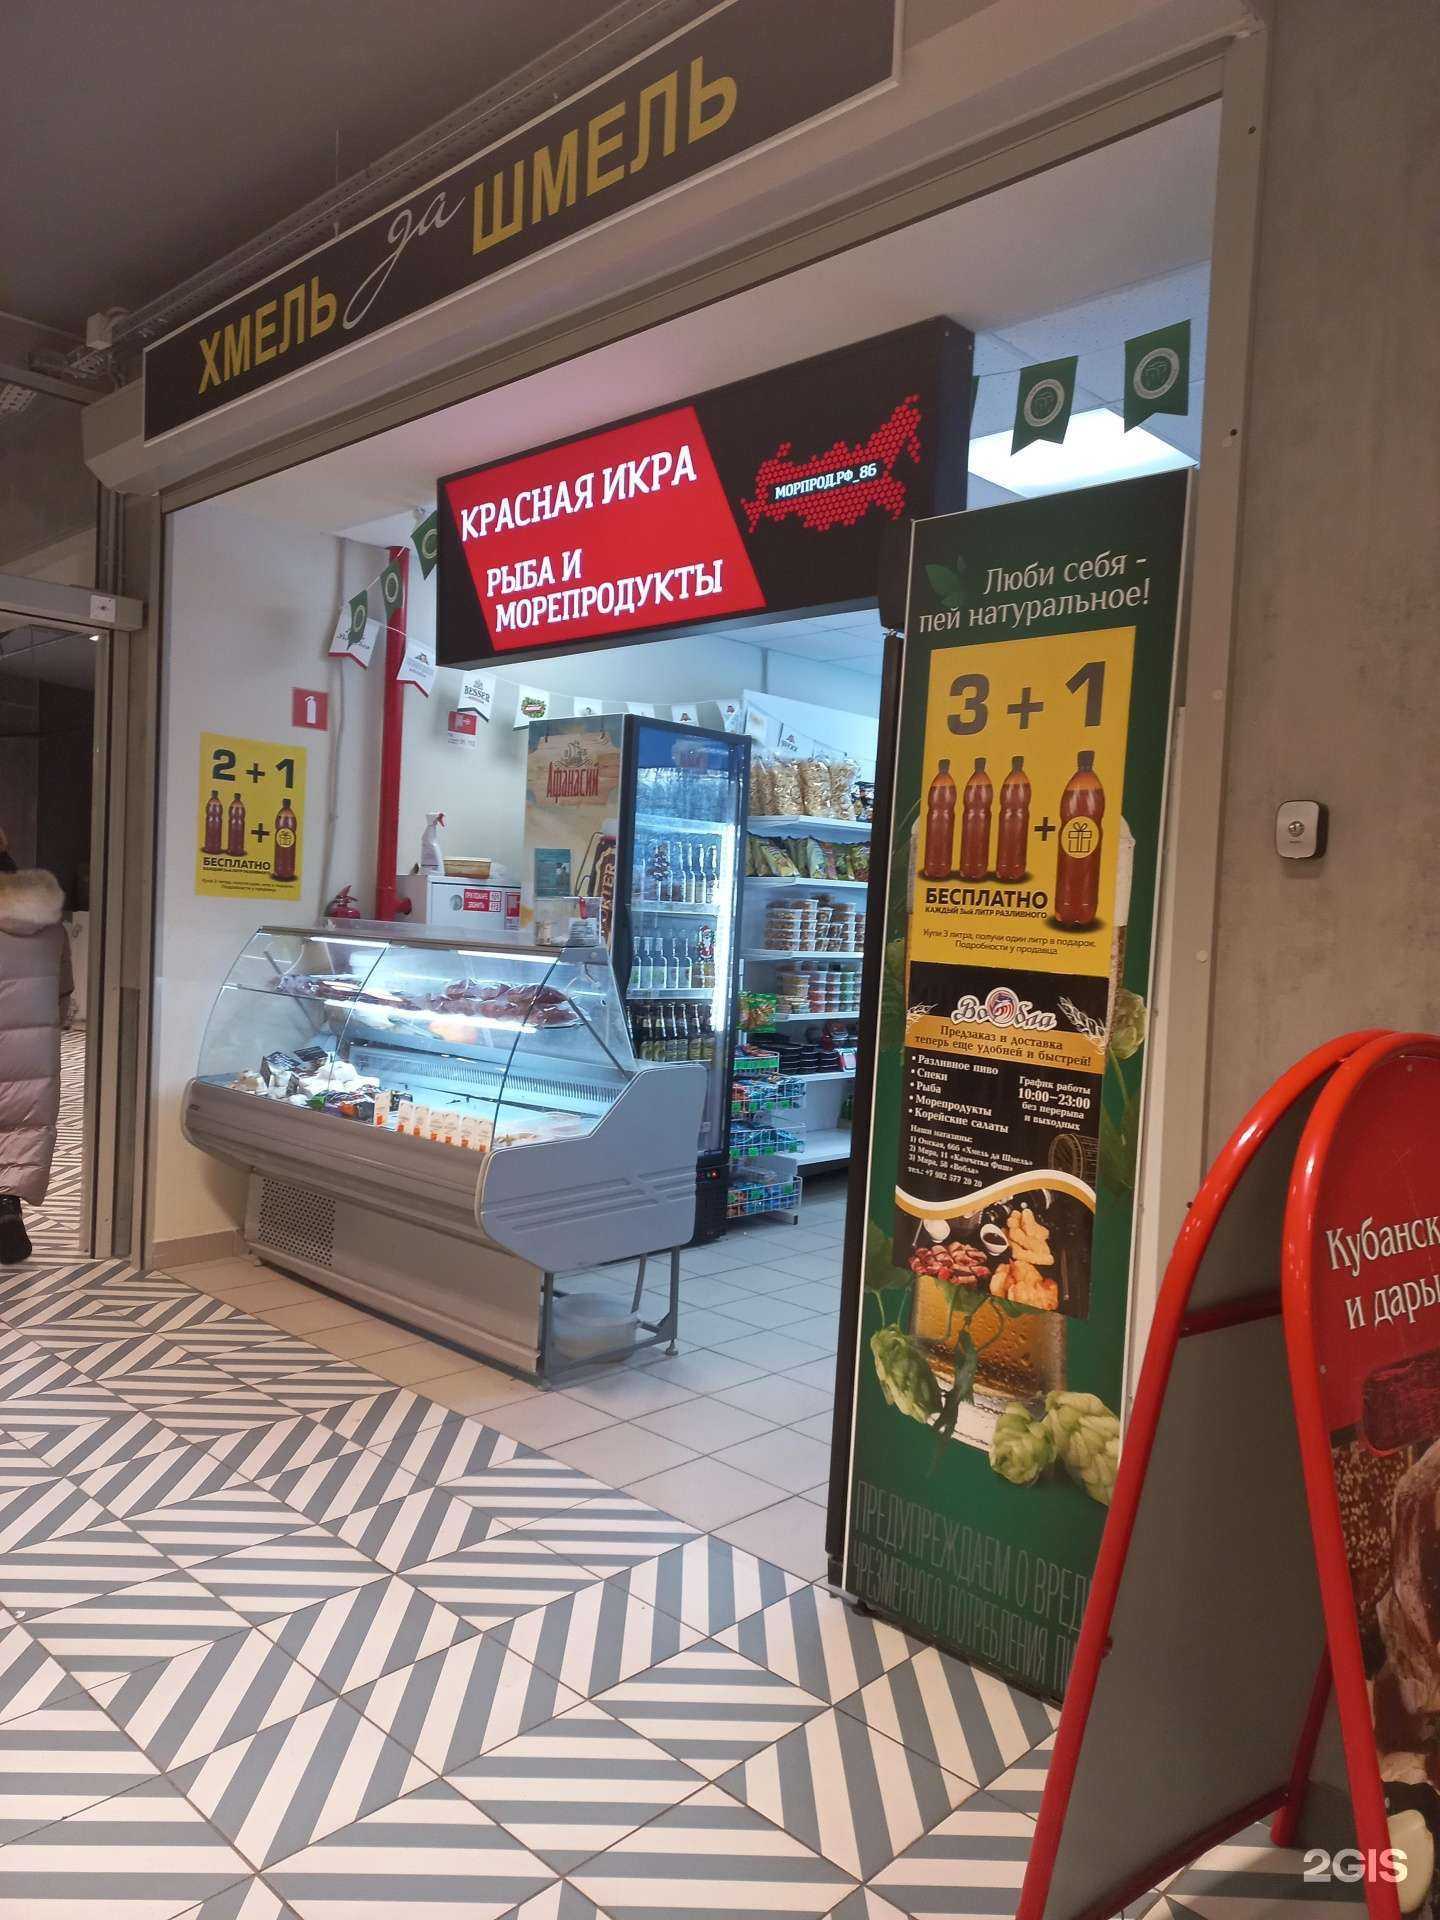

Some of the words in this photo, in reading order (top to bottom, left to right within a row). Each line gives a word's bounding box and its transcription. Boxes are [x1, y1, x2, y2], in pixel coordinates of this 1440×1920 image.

[198, 275, 338, 394] ХМЕЛЬ
[472, 55, 738, 255] ШМЕЛЬ
[461, 474, 594, 542] КРАСНАЯ
[601, 445, 697, 506] ИКРА
[775, 463, 877, 499] МОРПРОД.РФ_86
[486, 555, 555, 597] РЫБА
[562, 548, 582, 581] И
[984, 561, 1054, 595] Люби
[1063, 550, 1128, 580] себя
[495, 560, 723, 633] МОРЕПРОДУКТЫ
[919, 607, 960, 633] пей
[969, 578, 1150, 627] натуральное!
[947, 674, 990, 735] 3
[1007, 687, 1044, 729] +
[1065, 661, 1106, 727] 1
[212, 749, 236, 781] 2
[246, 763, 265, 783] +
[276, 758, 295, 789] 1
[203, 857, 271, 870] БЕСПЛАТНО
[925, 888, 1048, 909] БЕСПЛАТНО
[915, 1035, 949, 1048] теперь
[952, 1041, 973, 1051] еще
[977, 1044, 1023, 1056] удобней
[1027, 1051, 1034, 1059] и
[1038, 1050, 1092, 1066] быстрей!
[941, 1025, 996, 1041] Предзаказ
[1011, 1036, 1063, 1050] доставка
[916, 1068, 948, 1081] Снеки
[918, 1054, 970, 1071] Разливное
[973, 1064, 999, 1075] пиво
[916, 1081, 942, 1094] Рыба
[1019, 1076, 1054, 1089] График
[1056, 1082, 1091, 1095] работы
[914, 1107, 968, 1126] Корейские
[971, 1119, 1009, 1134] салаты
[915, 1094, 992, 1116] Морепродукты
[1022, 1101, 1037, 1111] без
[1039, 1105, 1084, 1119] перерыва
[1033, 1116, 1080, 1131] выходных
[1326, 1216, 1440, 1277] Кубанск
[1345, 1296, 1366, 1329] и
[855, 1480, 1010, 1599] ПРЕДУПРЕЖДАЕМ
[1015, 1550, 1029, 1608] О
[853, 1538, 943, 1630] ЧРЕЗМЕРНОГО
[947, 1584, 1048, 1684] ПОТРЕБЛЕНИЯ
